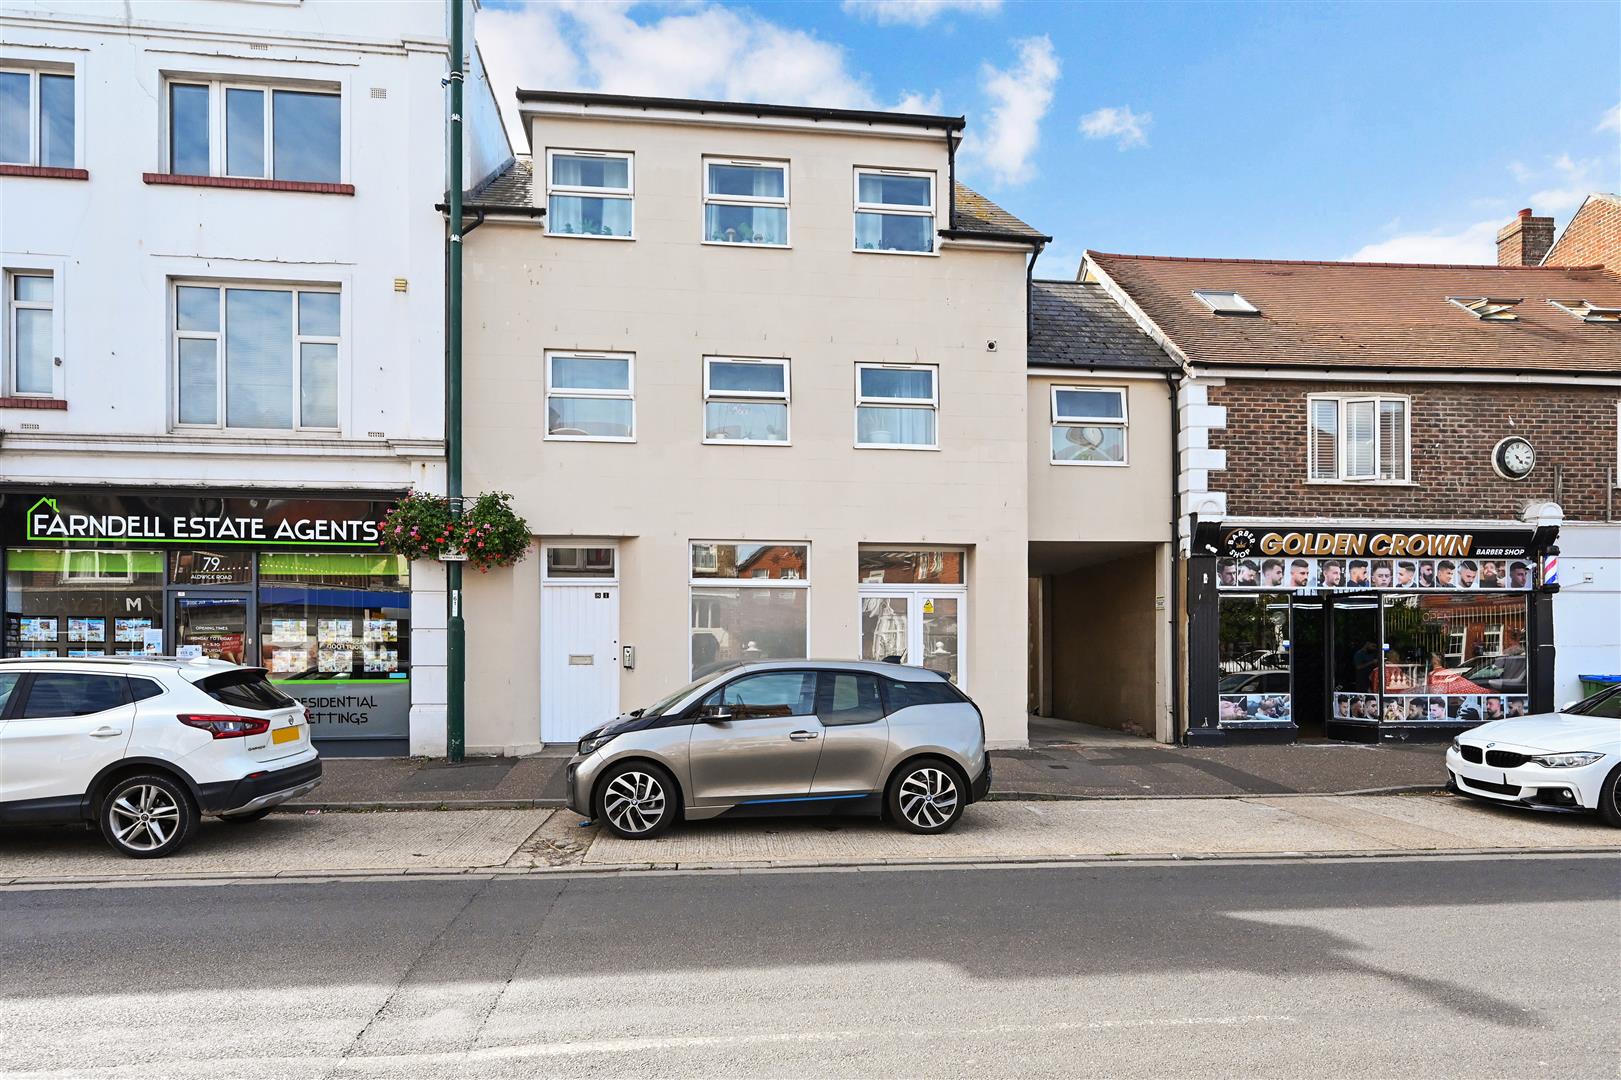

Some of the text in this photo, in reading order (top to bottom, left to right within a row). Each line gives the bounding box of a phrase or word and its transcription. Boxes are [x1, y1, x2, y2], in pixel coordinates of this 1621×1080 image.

[34, 514, 379, 541] FARNDELL ESTATE AGENTS
[1227, 530, 1256, 545] BARBER
[1260, 532, 1473, 557] GOLDEN CROWN
[1229, 548, 1250, 558] SHOP
[1476, 548, 1525, 556] BARBER SHOP
[203, 556, 221, 572] 79
[308, 712, 368, 725] ETTINGS
